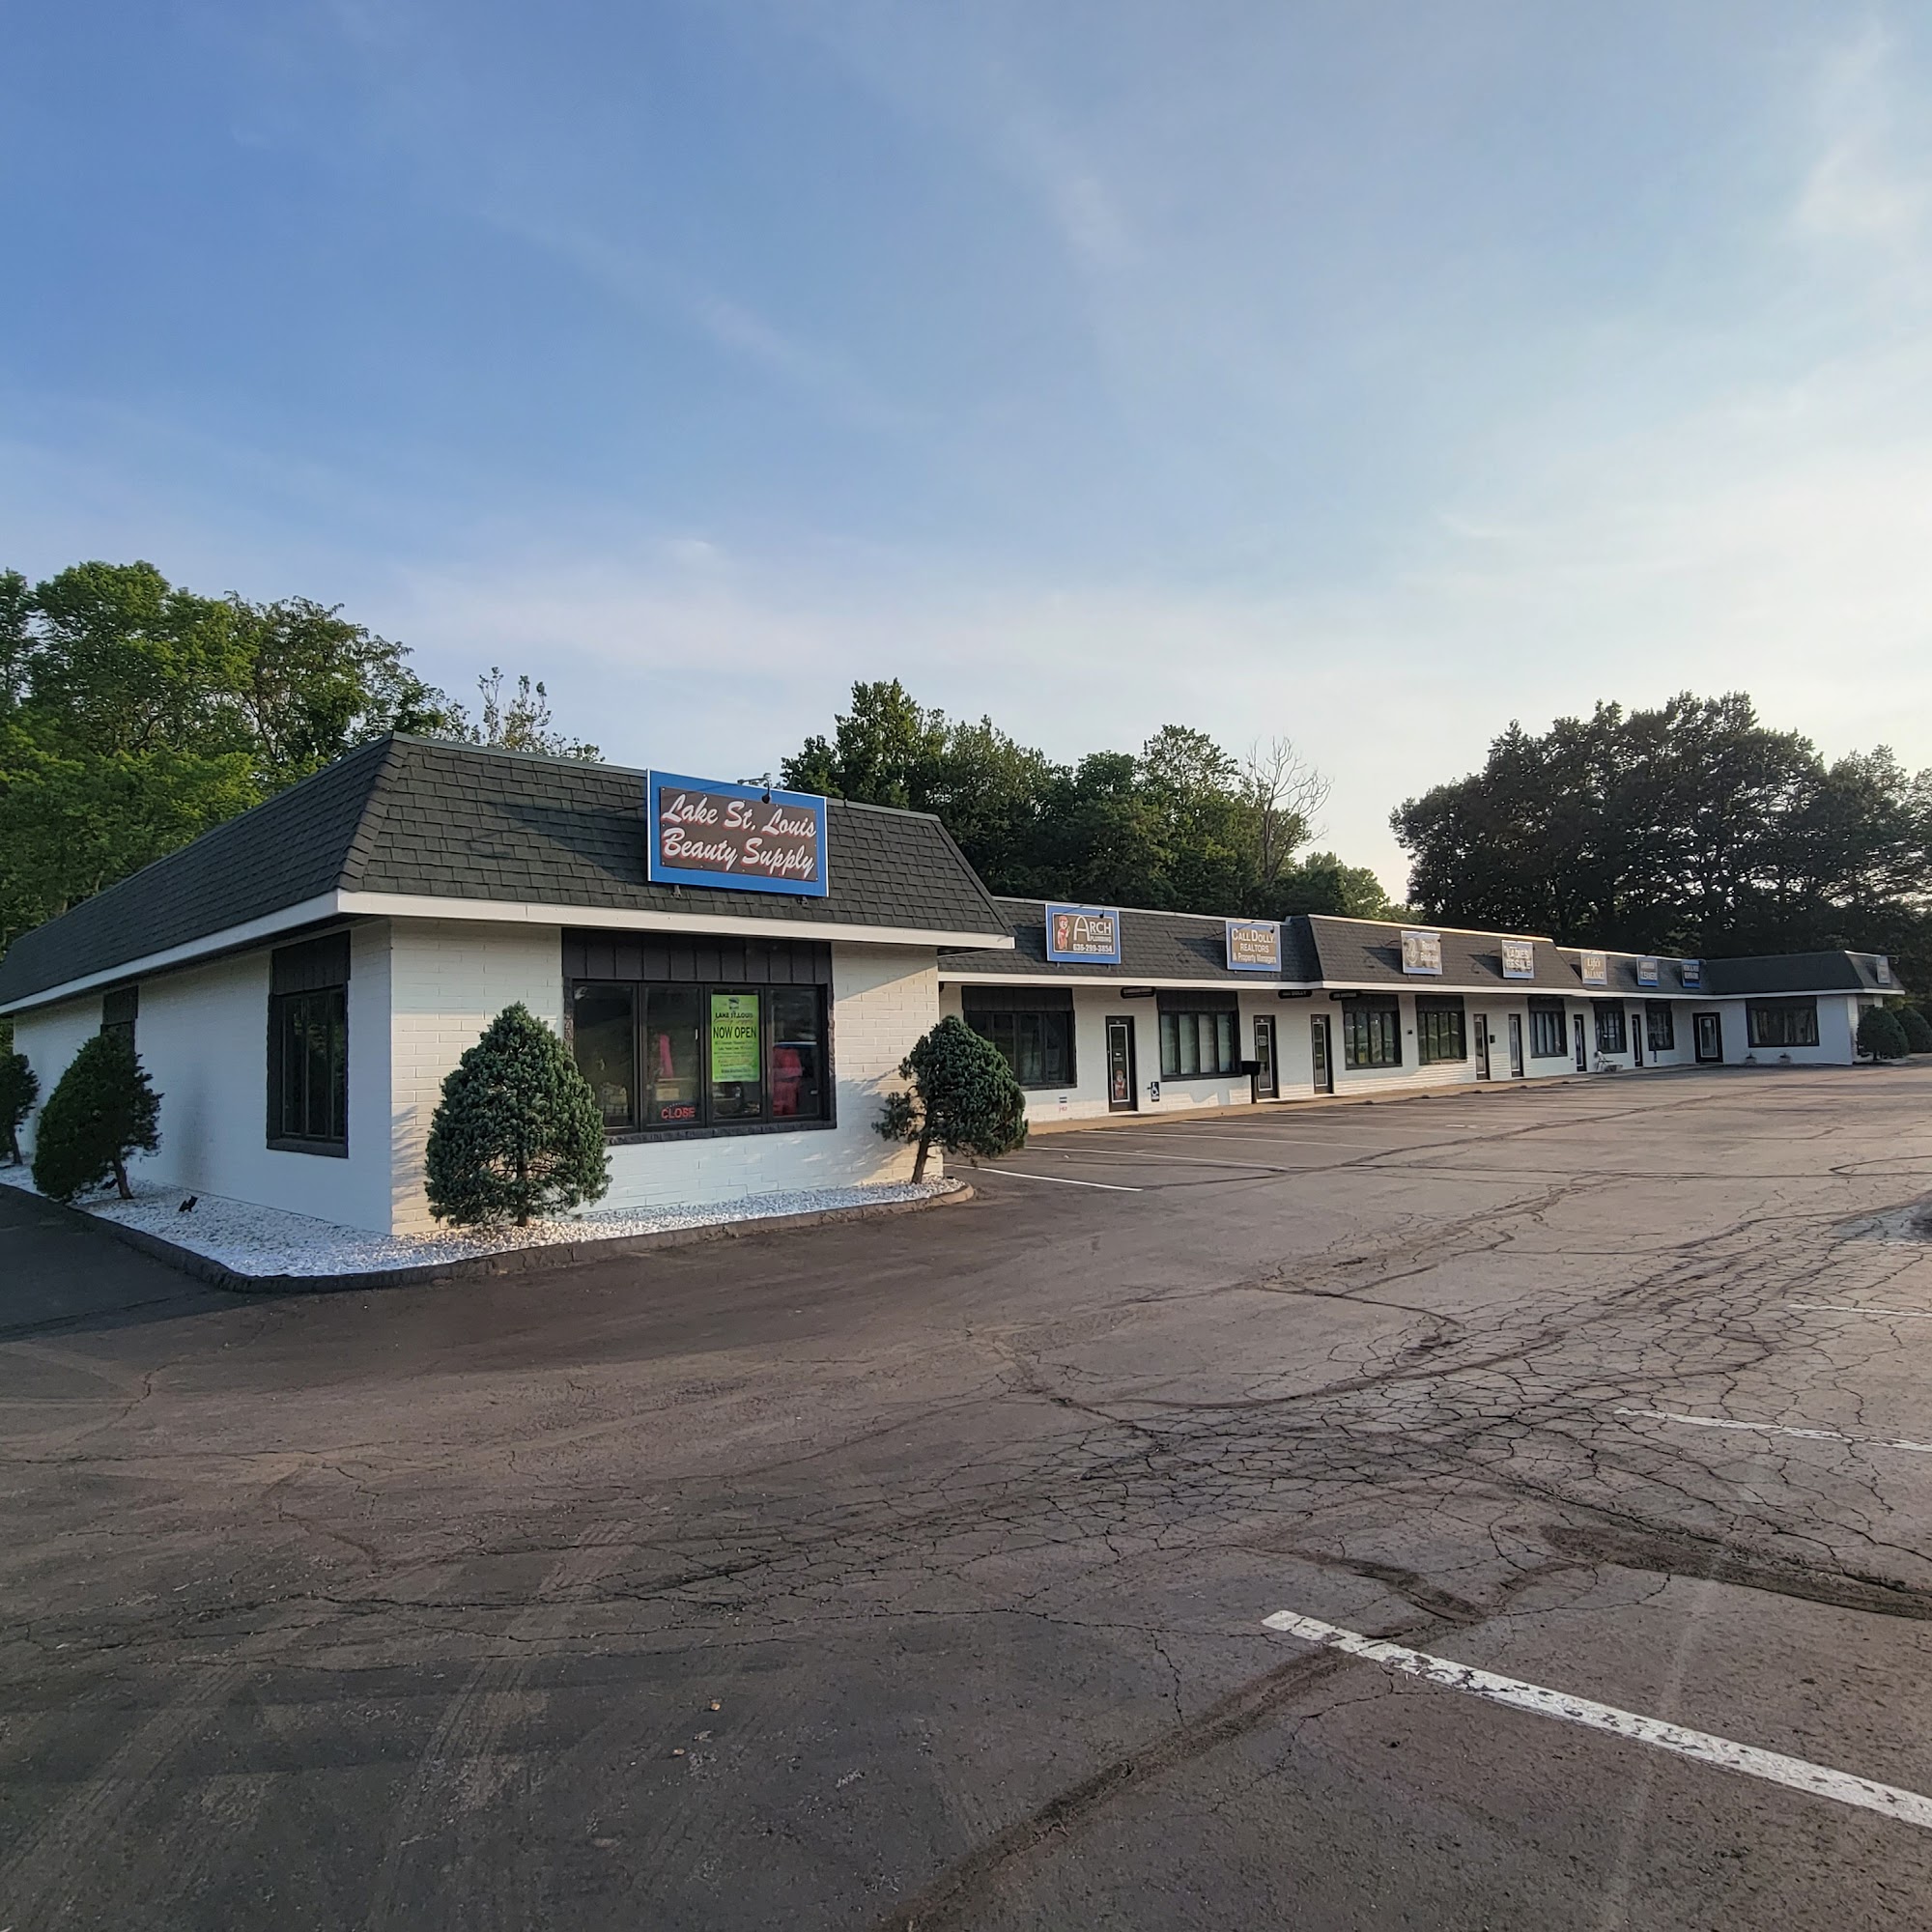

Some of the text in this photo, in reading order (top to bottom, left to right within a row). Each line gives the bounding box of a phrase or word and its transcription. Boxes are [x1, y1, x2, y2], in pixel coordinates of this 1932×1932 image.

[661, 793, 817, 838] Lake St. Louis
[663, 827, 815, 878] Beauty Supply
[1073, 916, 1112, 942] ARCH
[1232, 928, 1274, 944] CALL DOLLY
[1239, 943, 1269, 953] REALTORS
[713, 1026, 757, 1039] NOW OPEN
